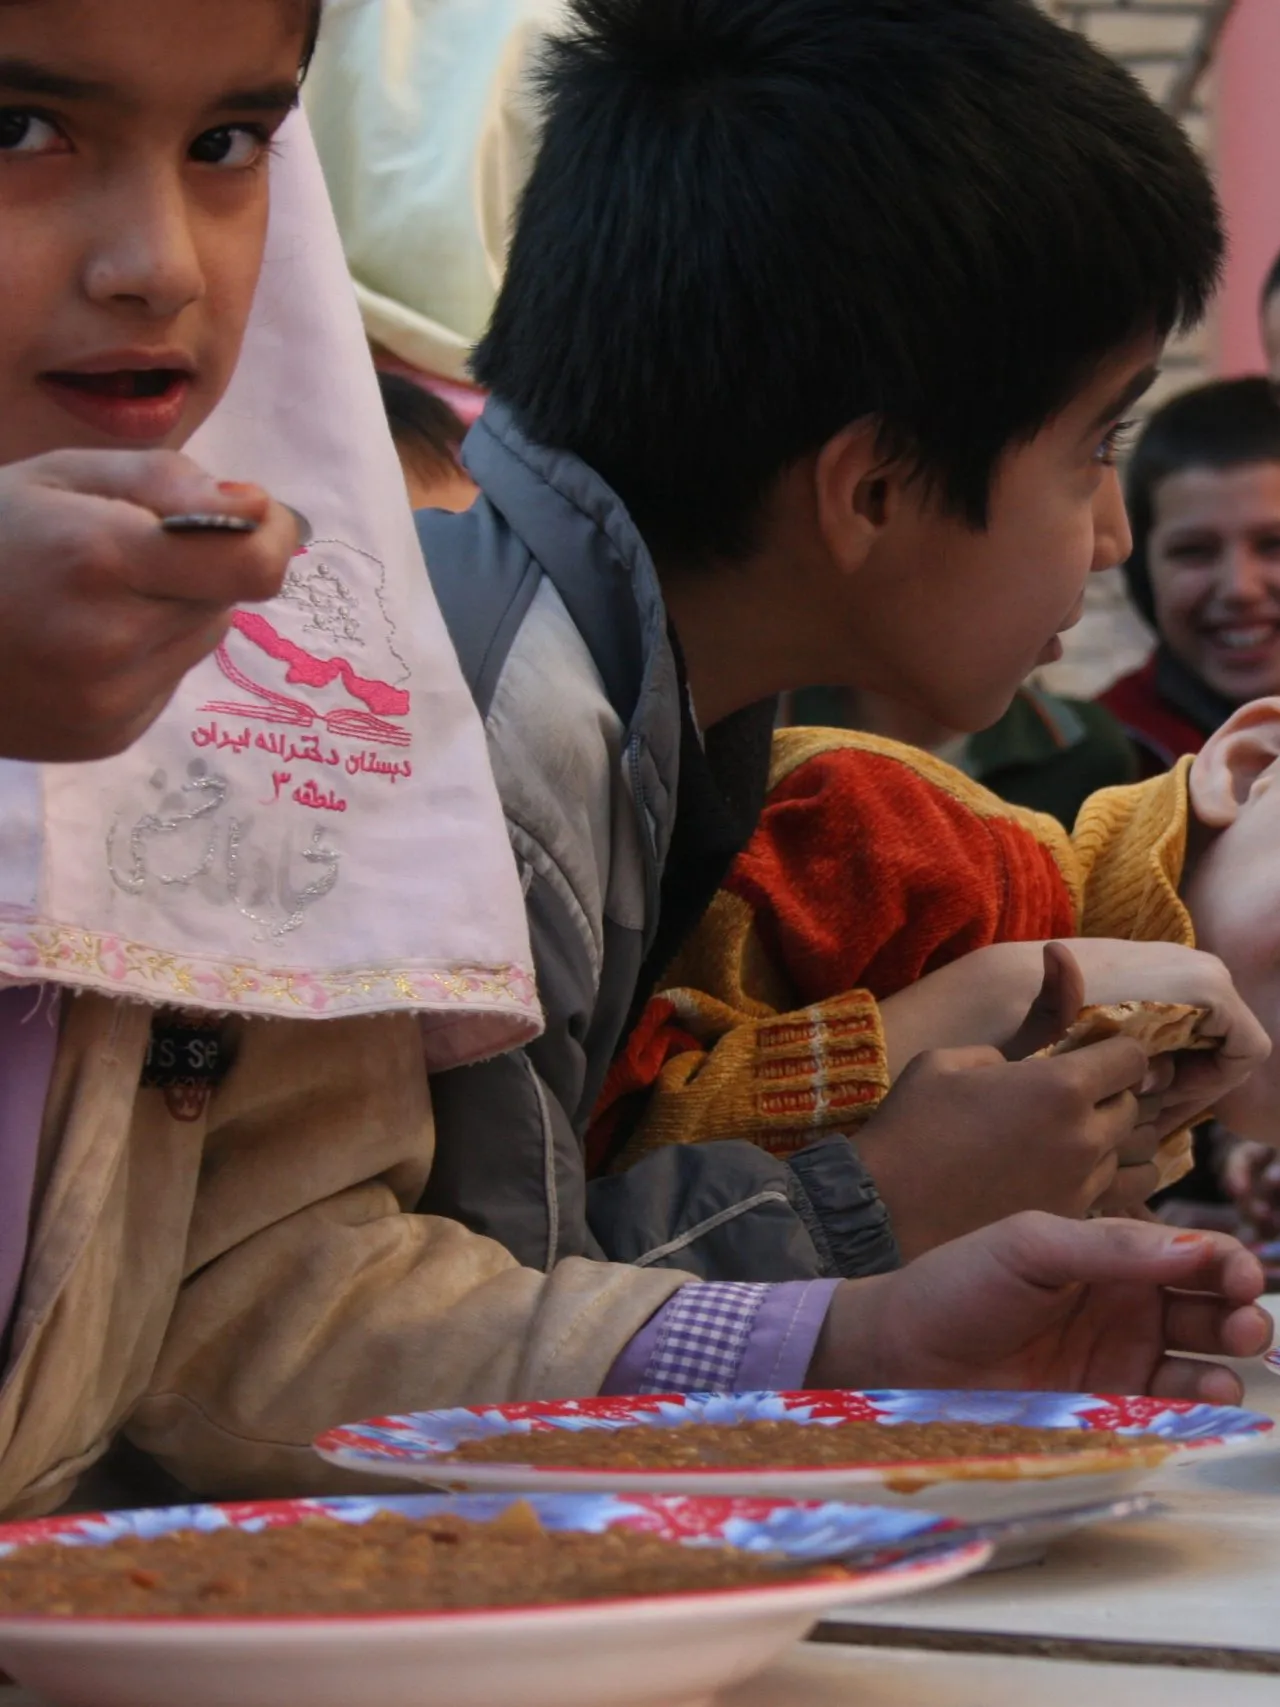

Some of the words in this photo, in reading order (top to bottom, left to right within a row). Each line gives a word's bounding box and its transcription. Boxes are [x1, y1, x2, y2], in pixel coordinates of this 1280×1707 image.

[191, 722, 251, 753] ایران
[255, 733, 340, 764] دخترانه
[346, 751, 412, 783] دبستان
[292, 779, 347, 812] منطقه
